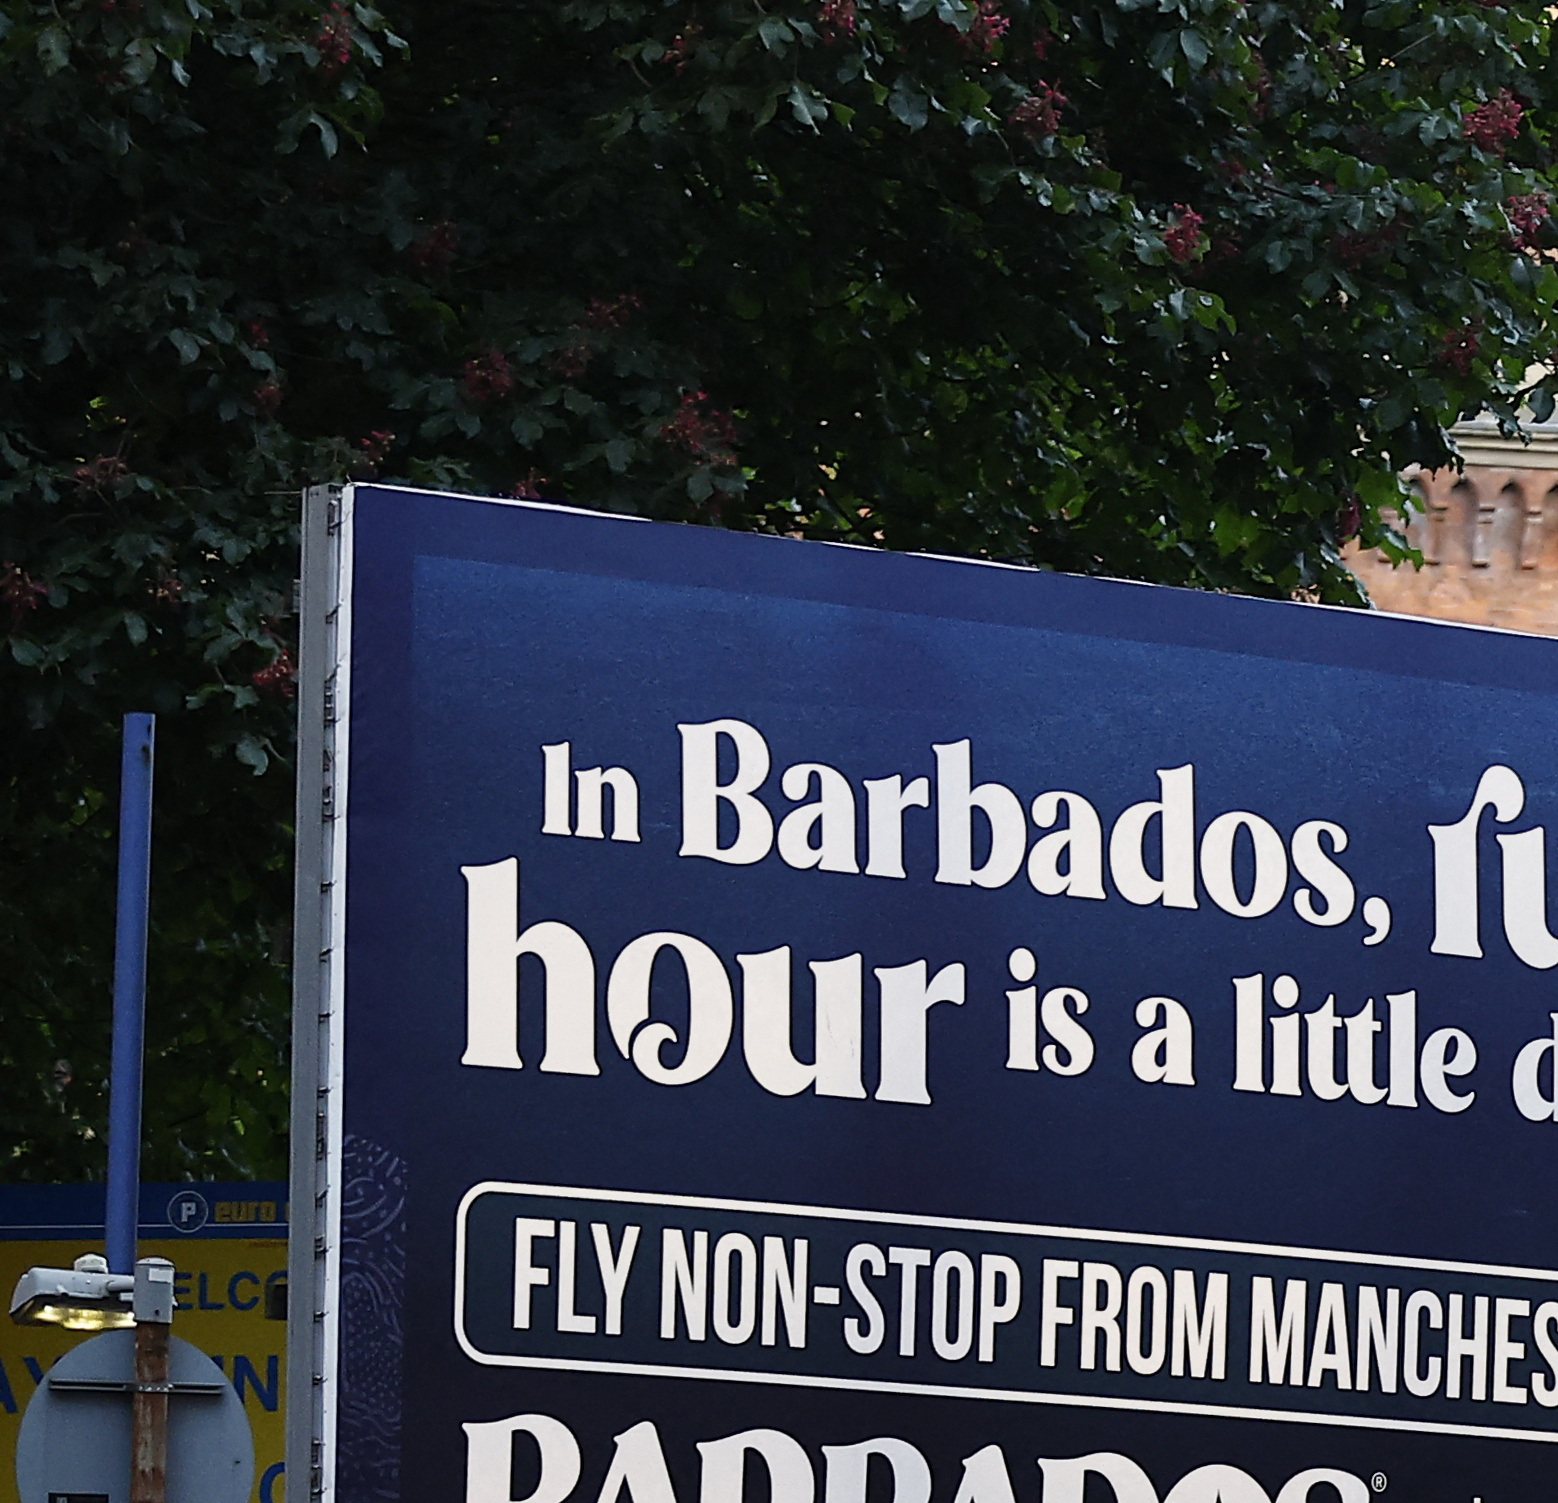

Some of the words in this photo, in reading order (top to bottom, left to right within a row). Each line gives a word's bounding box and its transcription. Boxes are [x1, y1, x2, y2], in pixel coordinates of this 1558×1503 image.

[541, 741, 641, 842] In
[676, 718, 1392, 947] Barbados,
[460, 856, 967, 1106] hour
[1005, 946, 1096, 1077] is
[1131, 995, 1196, 1087] a
[1232, 972, 1479, 1114] little
[513, 1217, 641, 1336] FLY
[659, 1227, 1021, 1363] NON-STOP
[1039, 1258, 1227, 1381] FROM
